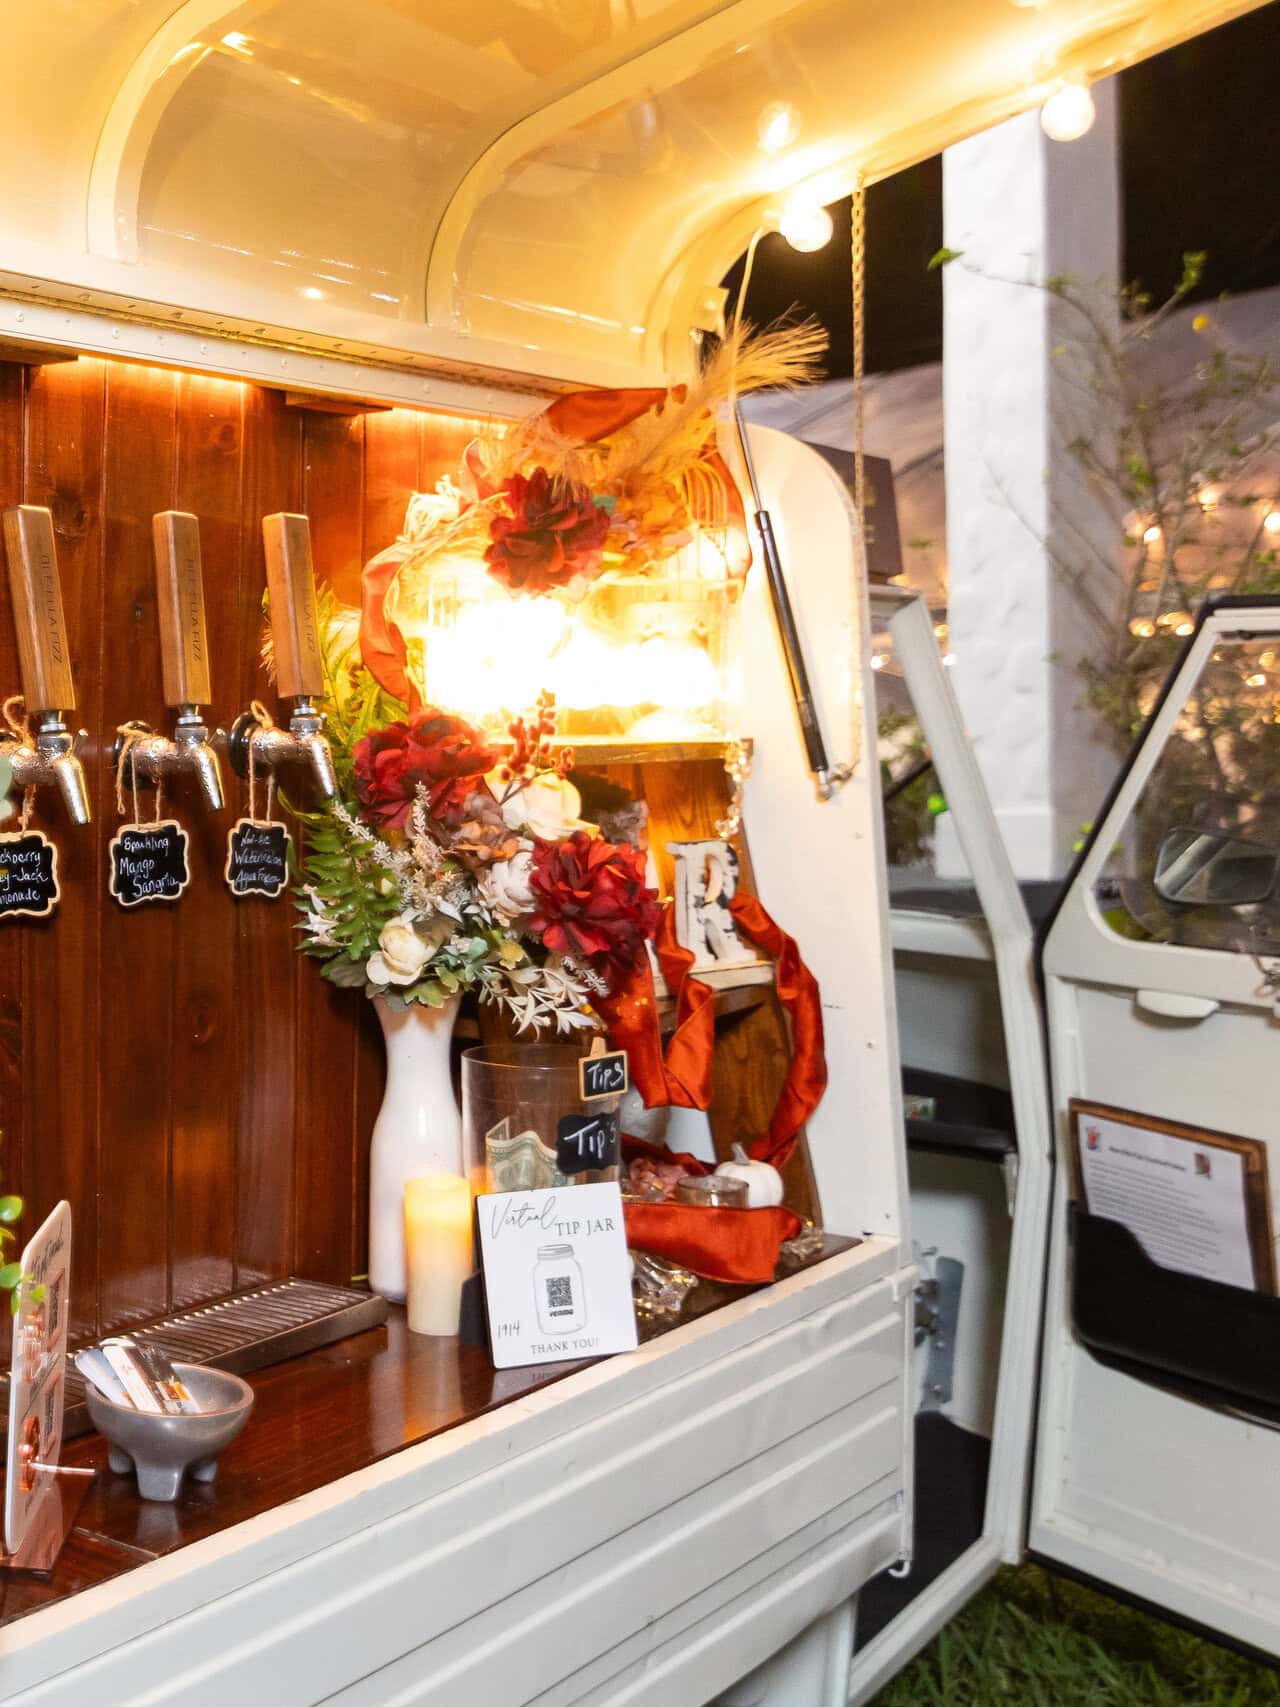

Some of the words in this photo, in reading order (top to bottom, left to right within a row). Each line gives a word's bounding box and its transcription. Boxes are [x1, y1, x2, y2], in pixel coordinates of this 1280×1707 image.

[119, 857, 155, 879] Mango
[131, 872, 179, 899] Sangria
[490, 1195, 558, 1239] Virtual
[554, 1221, 580, 1237] TIP
[586, 1217, 616, 1236] JAR
[497, 1319, 521, 1339] 1914
[530, 1340, 570, 1355] THANK
[572, 1336, 600, 1349] YOU!
